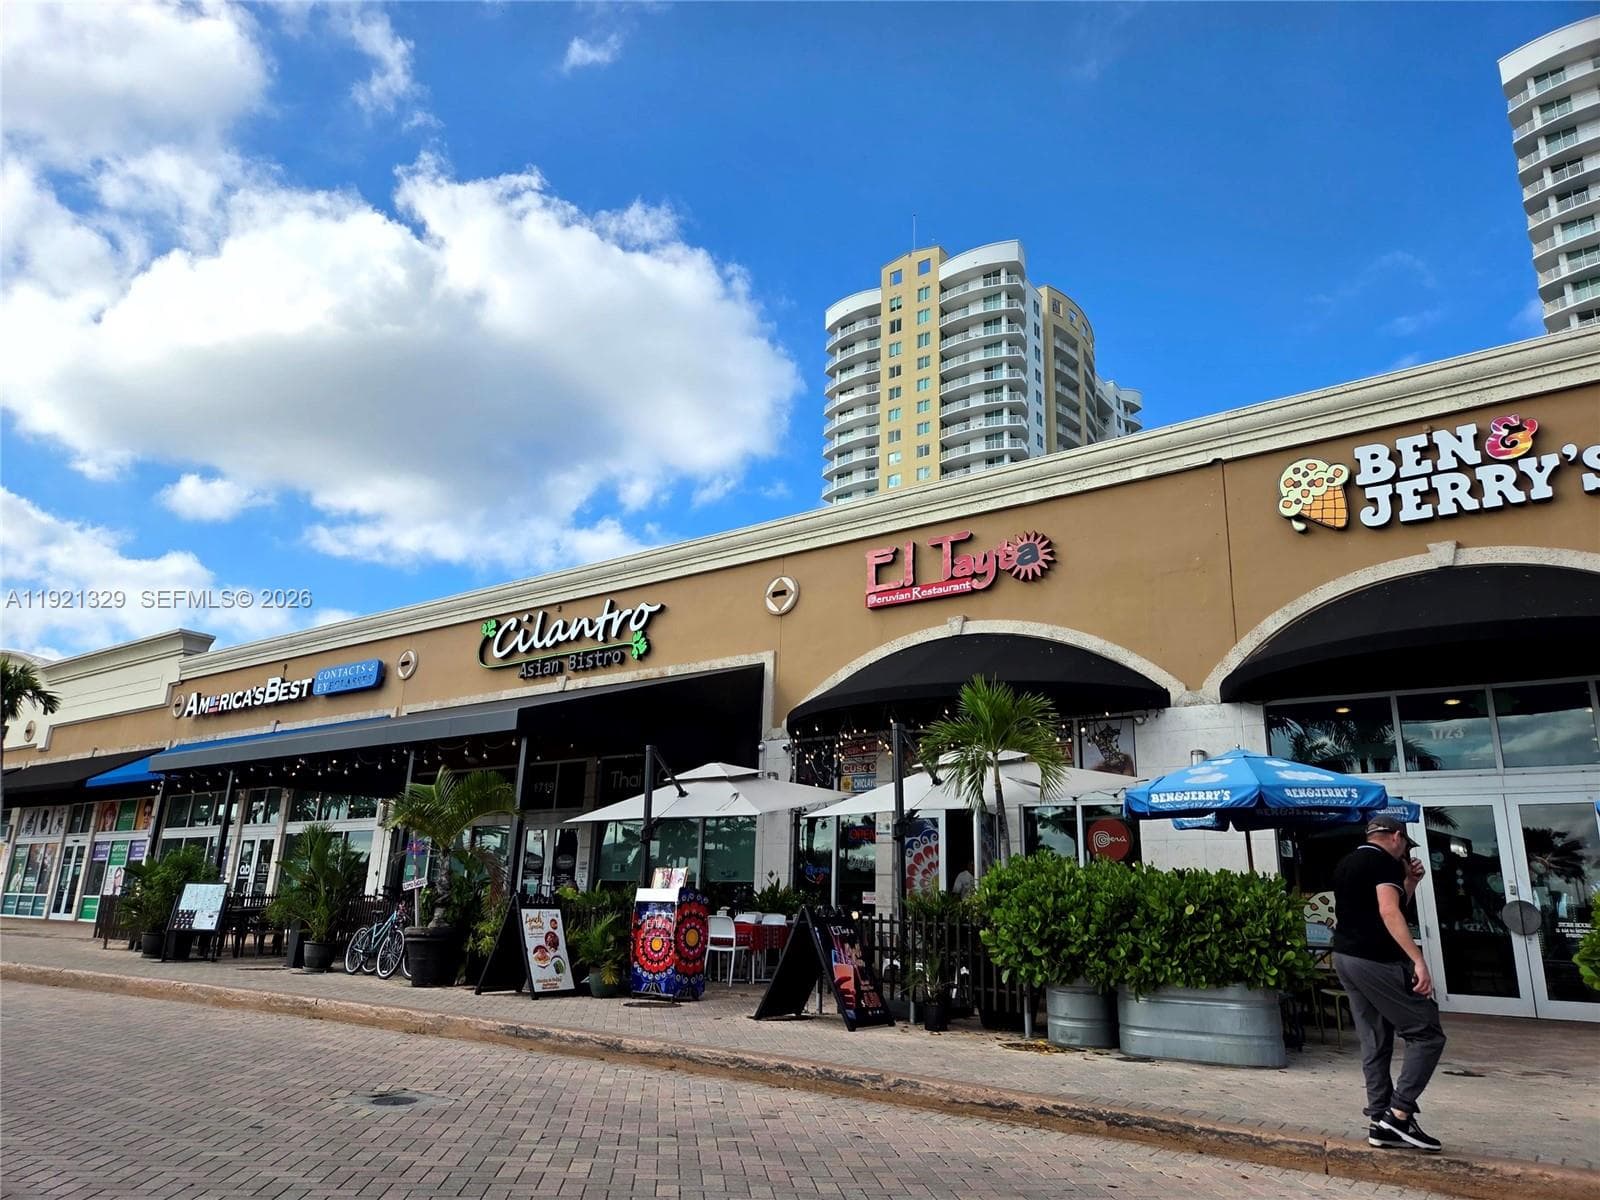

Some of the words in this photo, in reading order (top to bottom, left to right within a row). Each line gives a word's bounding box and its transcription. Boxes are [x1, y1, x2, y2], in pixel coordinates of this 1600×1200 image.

[1354, 423, 1482, 486] BEN
[1485, 415, 1539, 460] &
[865, 540, 915, 594] El
[927, 530, 1041, 590] Tayta
[867, 591, 912, 608] Peruvian
[911, 581, 972, 601] Restaurant
[493, 599, 662, 658] Cilantro
[318, 664, 366, 681] CONTACTS
[519, 658, 560, 679] Asian
[568, 649, 622, 671] Bistro
[610, 769, 643, 789] Thai
[1150, 789, 1231, 803] BEN&JERRY'S
[1284, 787, 1359, 799] BEN&JERRY'S
